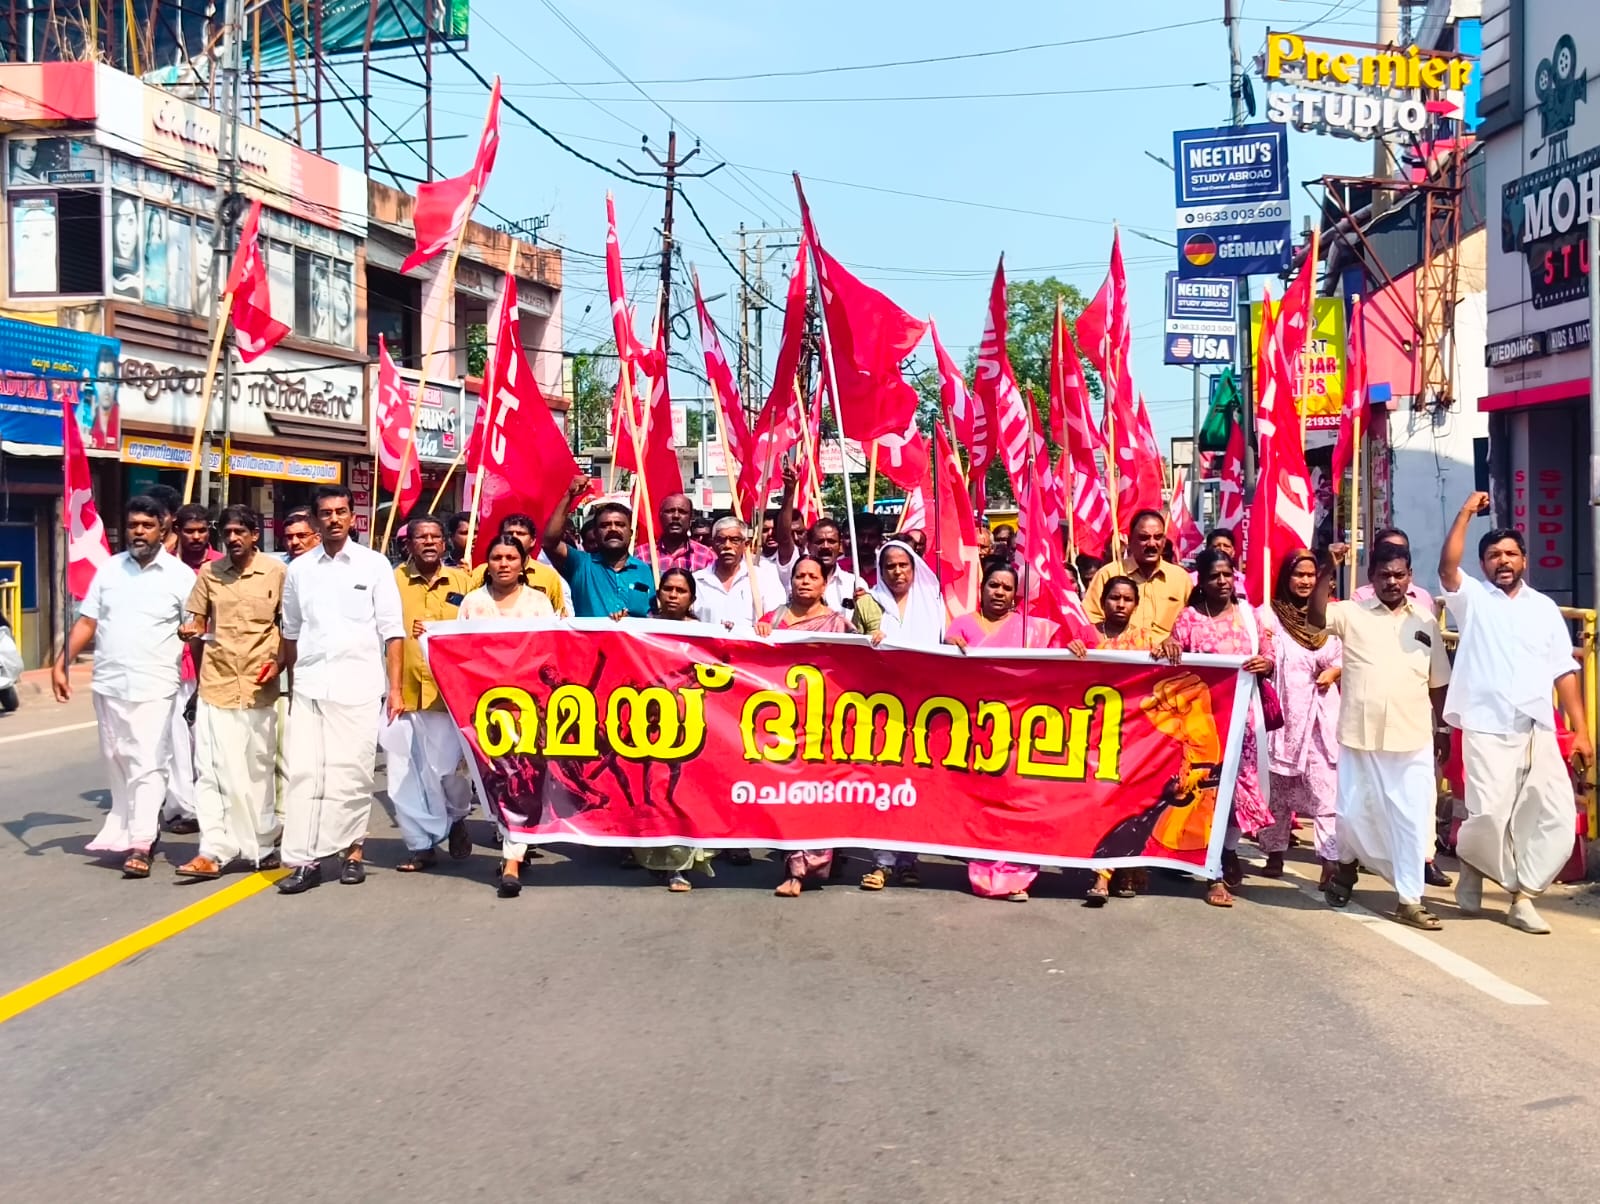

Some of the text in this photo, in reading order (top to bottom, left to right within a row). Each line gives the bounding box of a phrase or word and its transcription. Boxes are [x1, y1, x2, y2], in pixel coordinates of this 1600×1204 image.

[1266, 33, 1473, 90] Premier
[1266, 92, 1428, 131] STUDIO
[1189, 143, 1272, 168] NEETHU'S
[1191, 169, 1272, 184] STUDY ABROAD
[1197, 207, 1282, 222] 9633 003 500
[1218, 240, 1284, 258] GERMANY
[1177, 283, 1230, 298] NEETHU'S
[1177, 299, 1229, 308] STUDY ABROAD
[1192, 338, 1230, 360] USA
[1550, 329, 1567, 348] KIDS
[1568, 328, 1574, 345] &
[1490, 338, 1534, 362] WEDDING
[1538, 469, 1564, 568] STUDIO
[474, 663, 1124, 783] മെയ് ദിനറാലി
[730, 778, 918, 811] ചെങ്ങന്നൂർ
